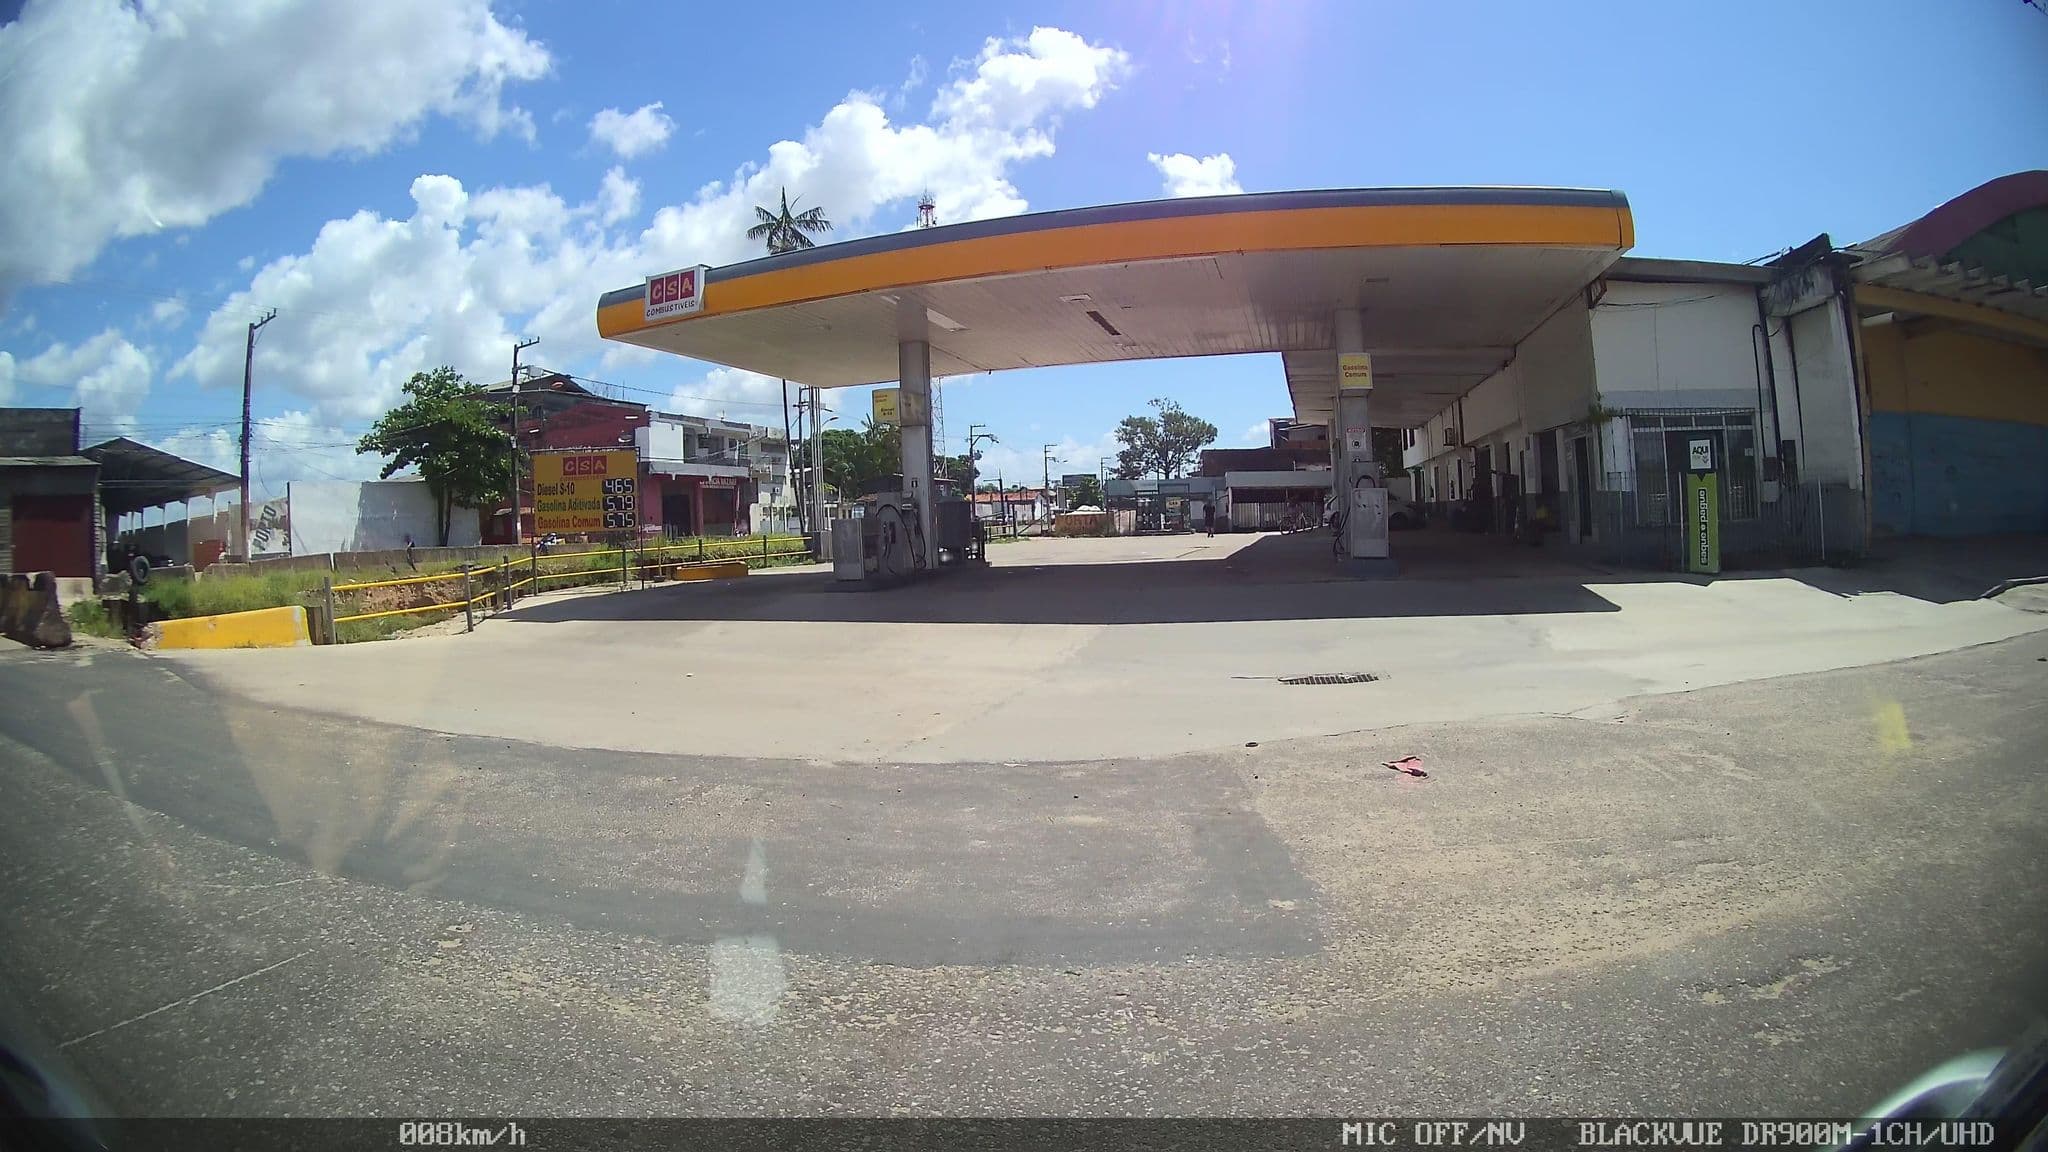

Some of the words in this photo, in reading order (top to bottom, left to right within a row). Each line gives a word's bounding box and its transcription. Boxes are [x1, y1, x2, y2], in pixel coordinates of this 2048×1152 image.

[651, 276, 693, 300] CSA
[1691, 446, 1709, 455] AQUI
[564, 459, 606, 473] CSA
[537, 483, 558, 496] Diesel
[560, 482, 575, 495] S-10
[537, 500, 567, 512] Gasolina
[1700, 490, 1708, 522] pague
[538, 516, 570, 529] Gasolina
[572, 515, 601, 528] Comum
[1700, 532, 1709, 564] saque
